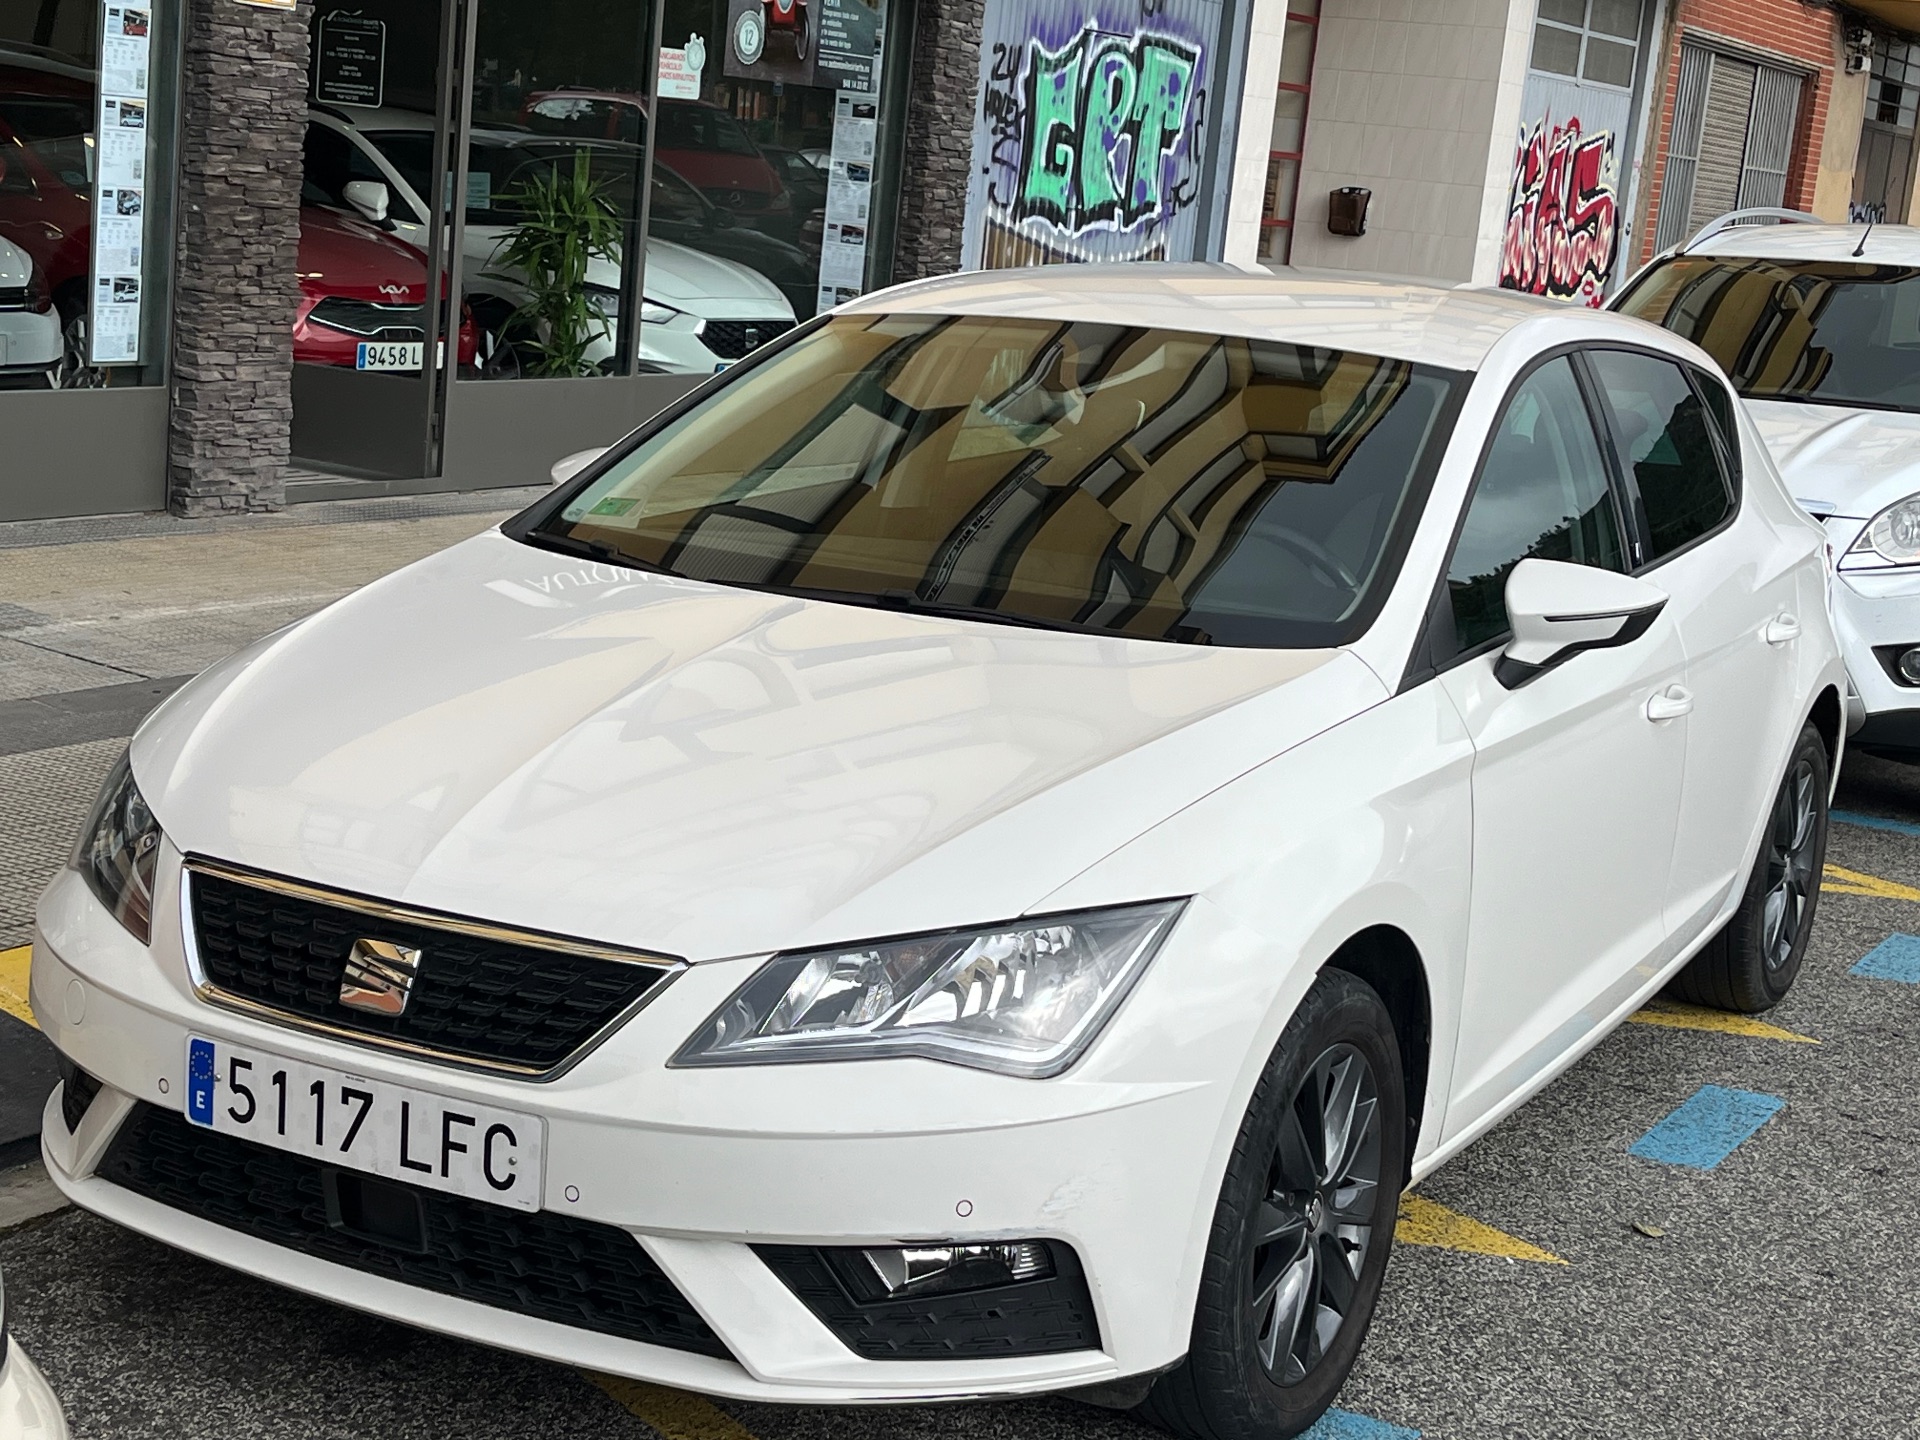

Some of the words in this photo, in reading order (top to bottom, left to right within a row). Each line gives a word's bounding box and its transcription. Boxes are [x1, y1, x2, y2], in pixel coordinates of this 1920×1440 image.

[744, 28, 754, 46] 12
[367, 346, 407, 366] 9458
[195, 1090, 206, 1110] E
[227, 1056, 374, 1153] 5117
[399, 1100, 518, 1192] LFC
